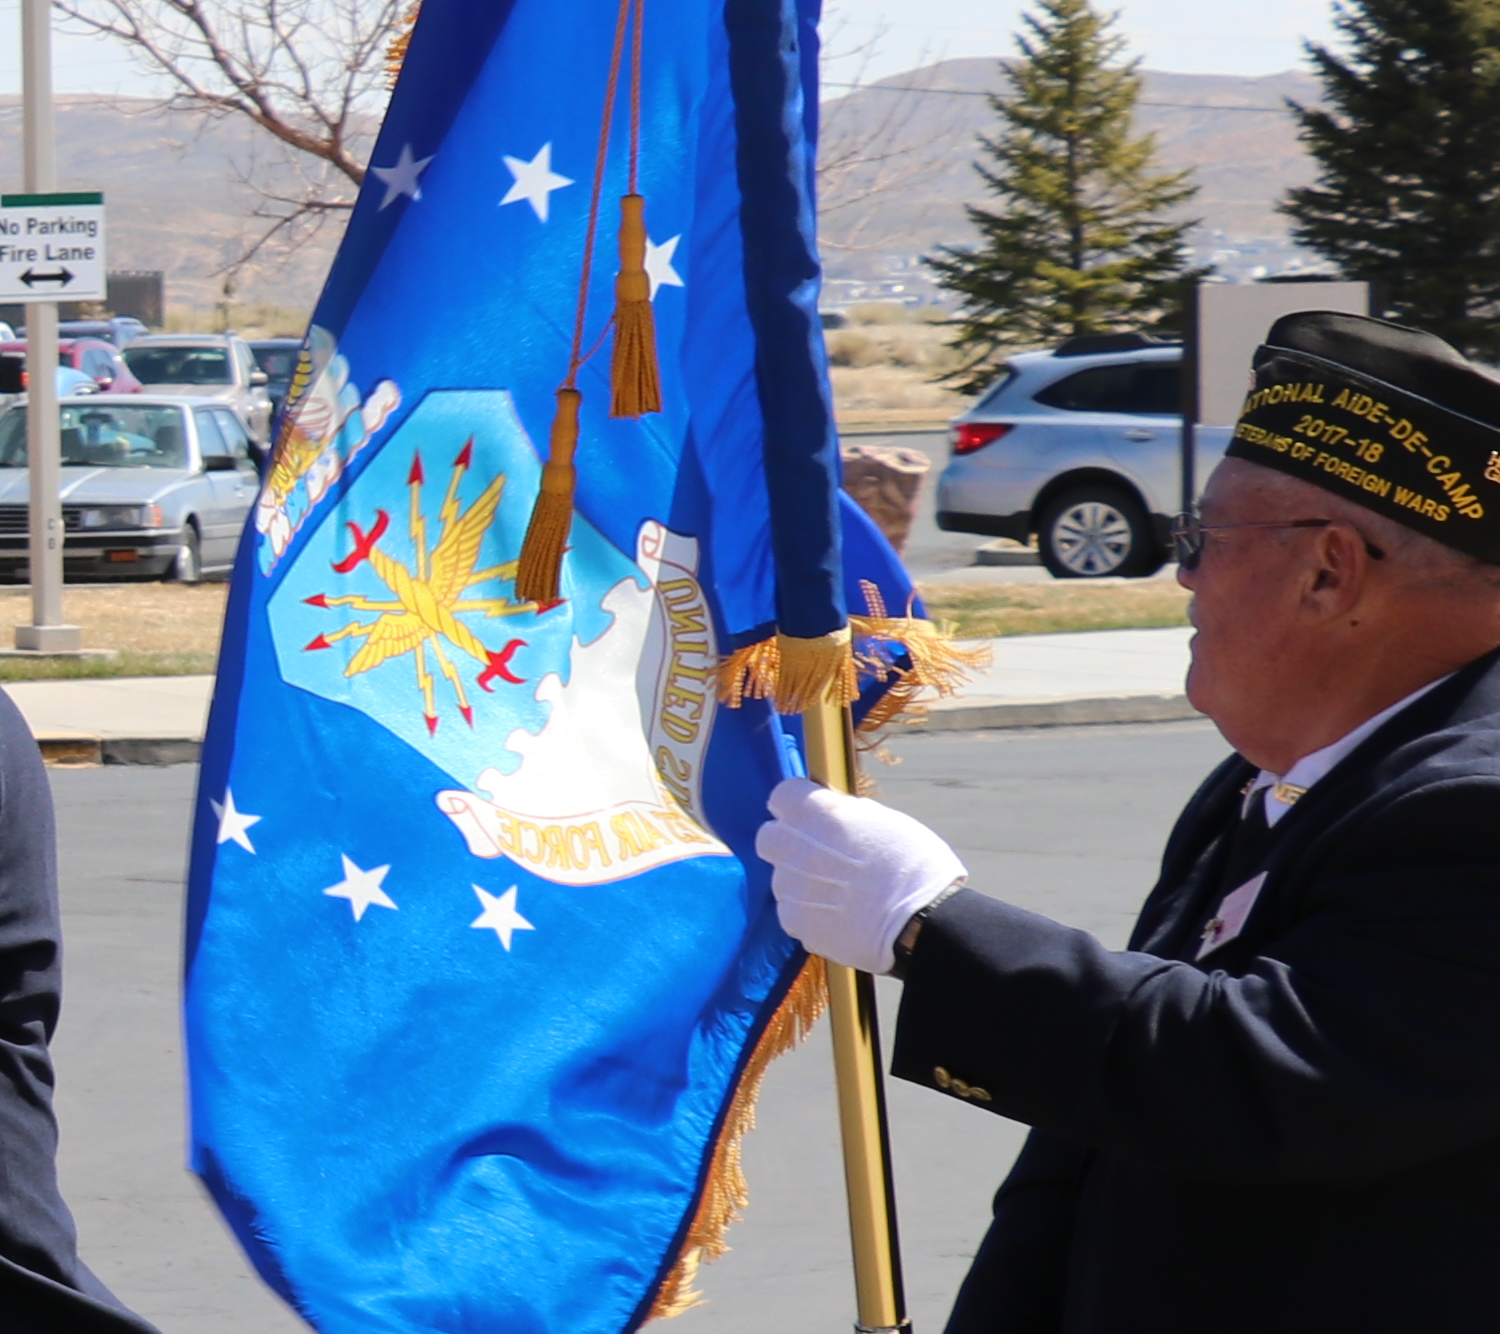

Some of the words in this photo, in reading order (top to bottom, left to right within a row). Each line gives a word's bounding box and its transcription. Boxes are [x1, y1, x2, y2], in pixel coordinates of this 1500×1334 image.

[26, 216, 99, 238] Parking
[45, 243, 95, 261] Lane
[1240, 383, 1324, 417] ATIONAL
[1293, 414, 1384, 463] 2017-18
[1235, 422, 1293, 452] ETERANS
[1290, 442, 1316, 461] OF
[1312, 452, 1392, 498] FOREIGN
[1393, 486, 1450, 521] WARS
